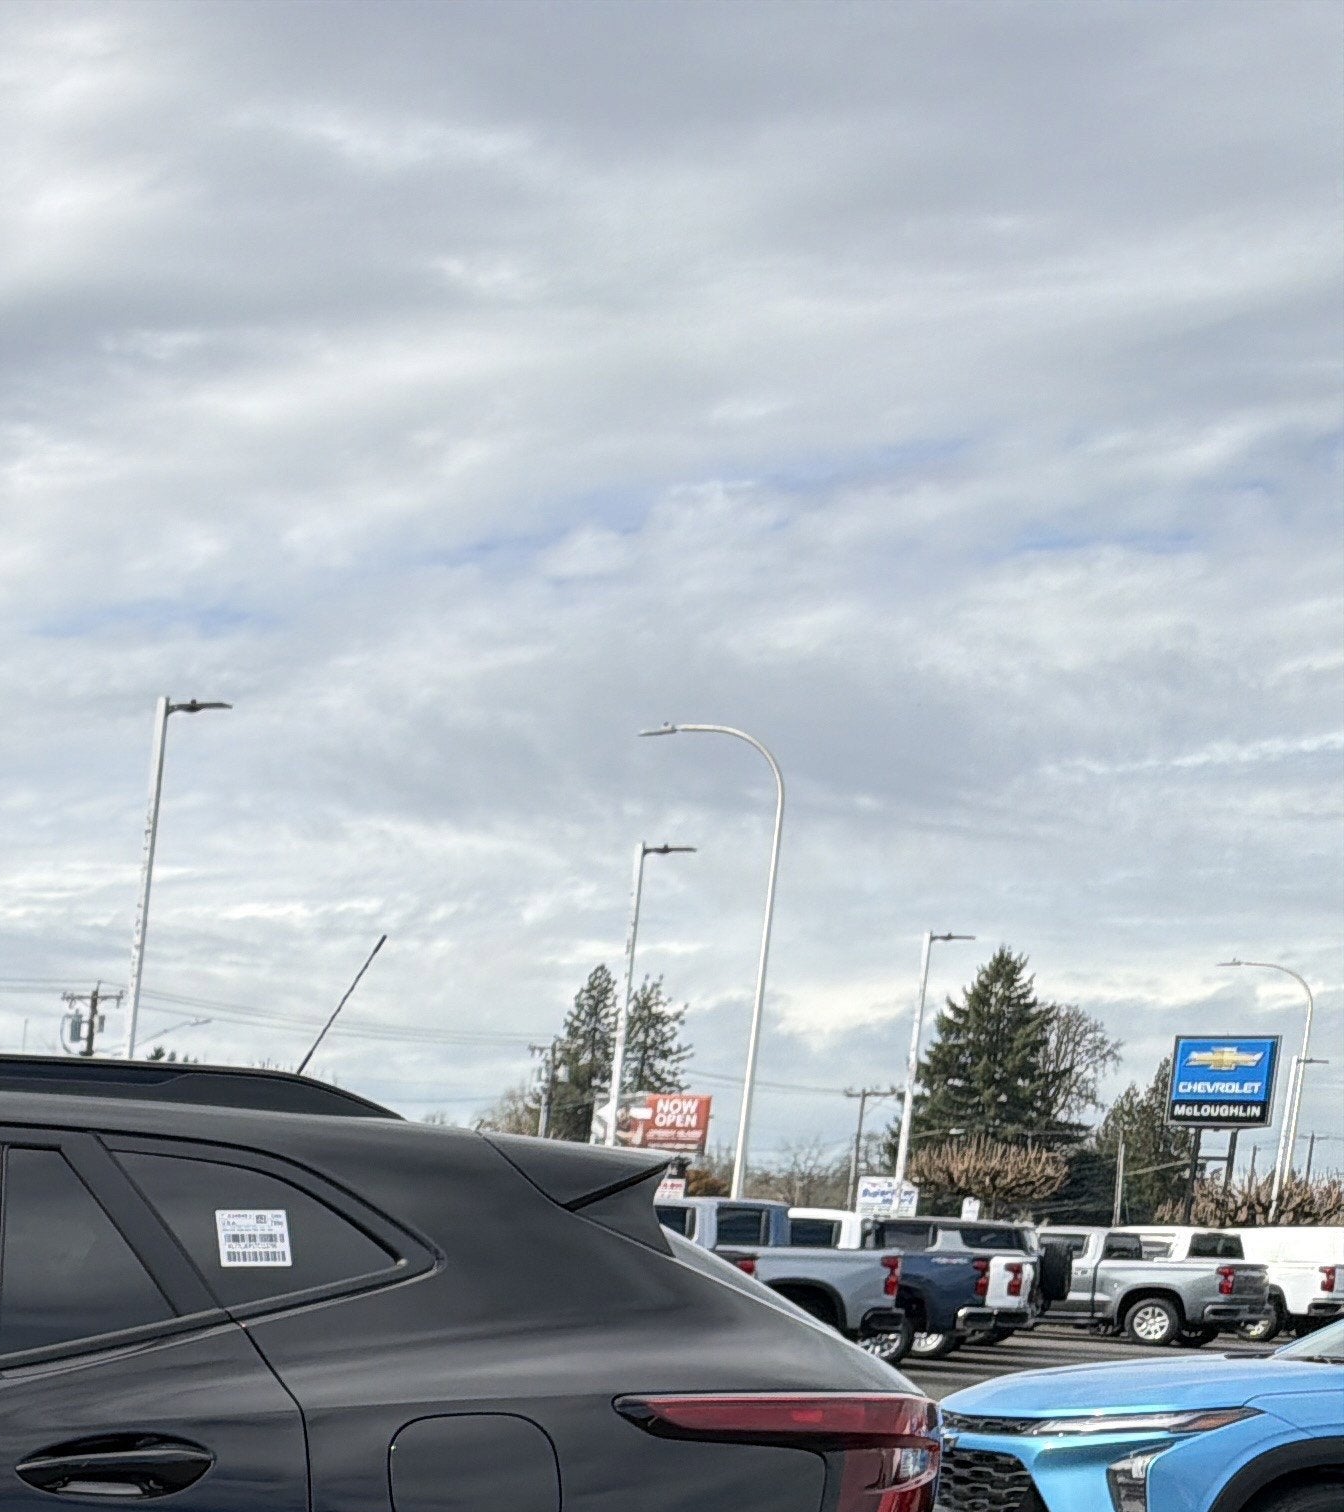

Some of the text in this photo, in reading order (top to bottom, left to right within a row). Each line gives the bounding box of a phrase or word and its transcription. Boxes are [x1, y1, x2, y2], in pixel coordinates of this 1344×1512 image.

[1178, 1081, 1262, 1094] CHEVROLET
[657, 1098, 699, 1114] NOW
[1173, 1103, 1261, 1118] McLOUGHLIN
[654, 1113, 698, 1127] OPEN
